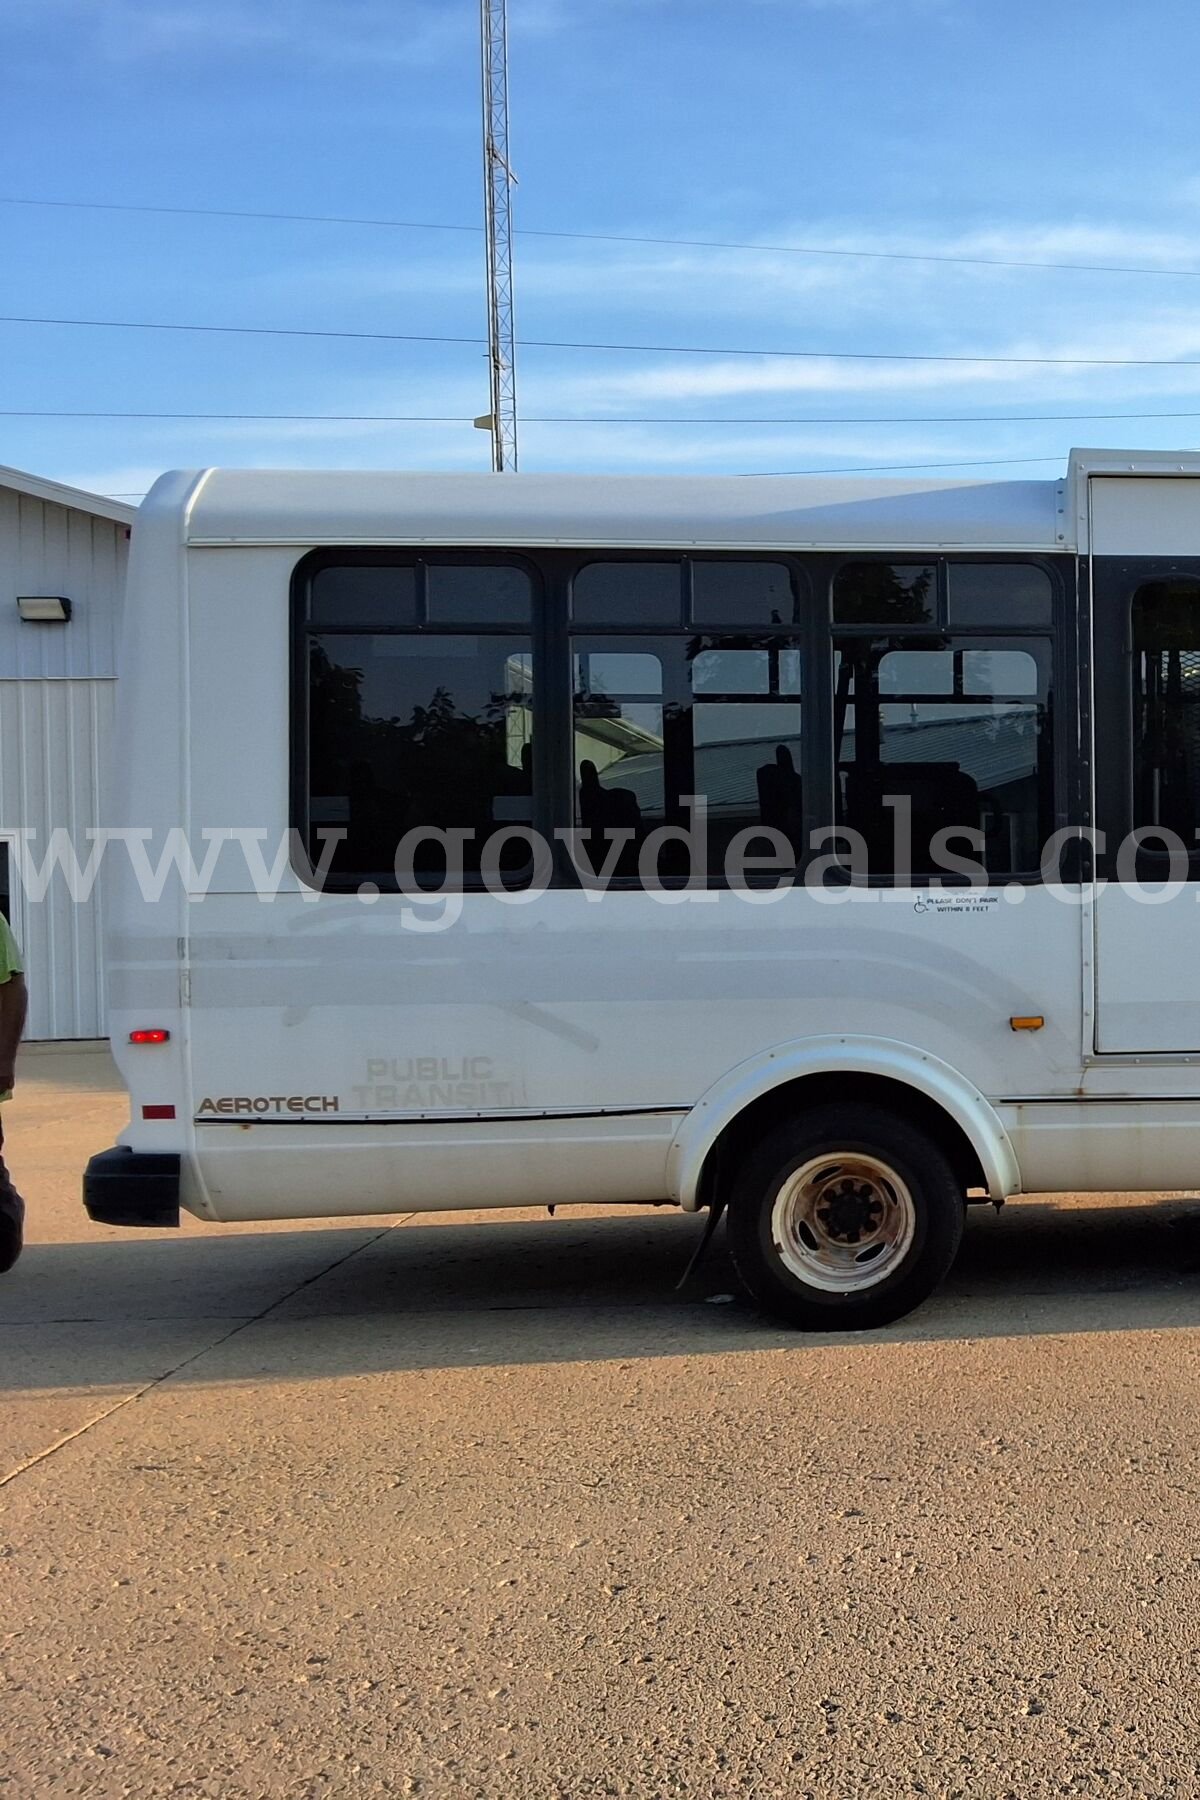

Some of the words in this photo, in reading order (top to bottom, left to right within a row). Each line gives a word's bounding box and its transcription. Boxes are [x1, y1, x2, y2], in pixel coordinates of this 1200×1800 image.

[366, 1056, 494, 1082] PUBLIC
[198, 1096, 340, 1114] AEROTECH
[352, 1081, 512, 1108] TRANSIT
